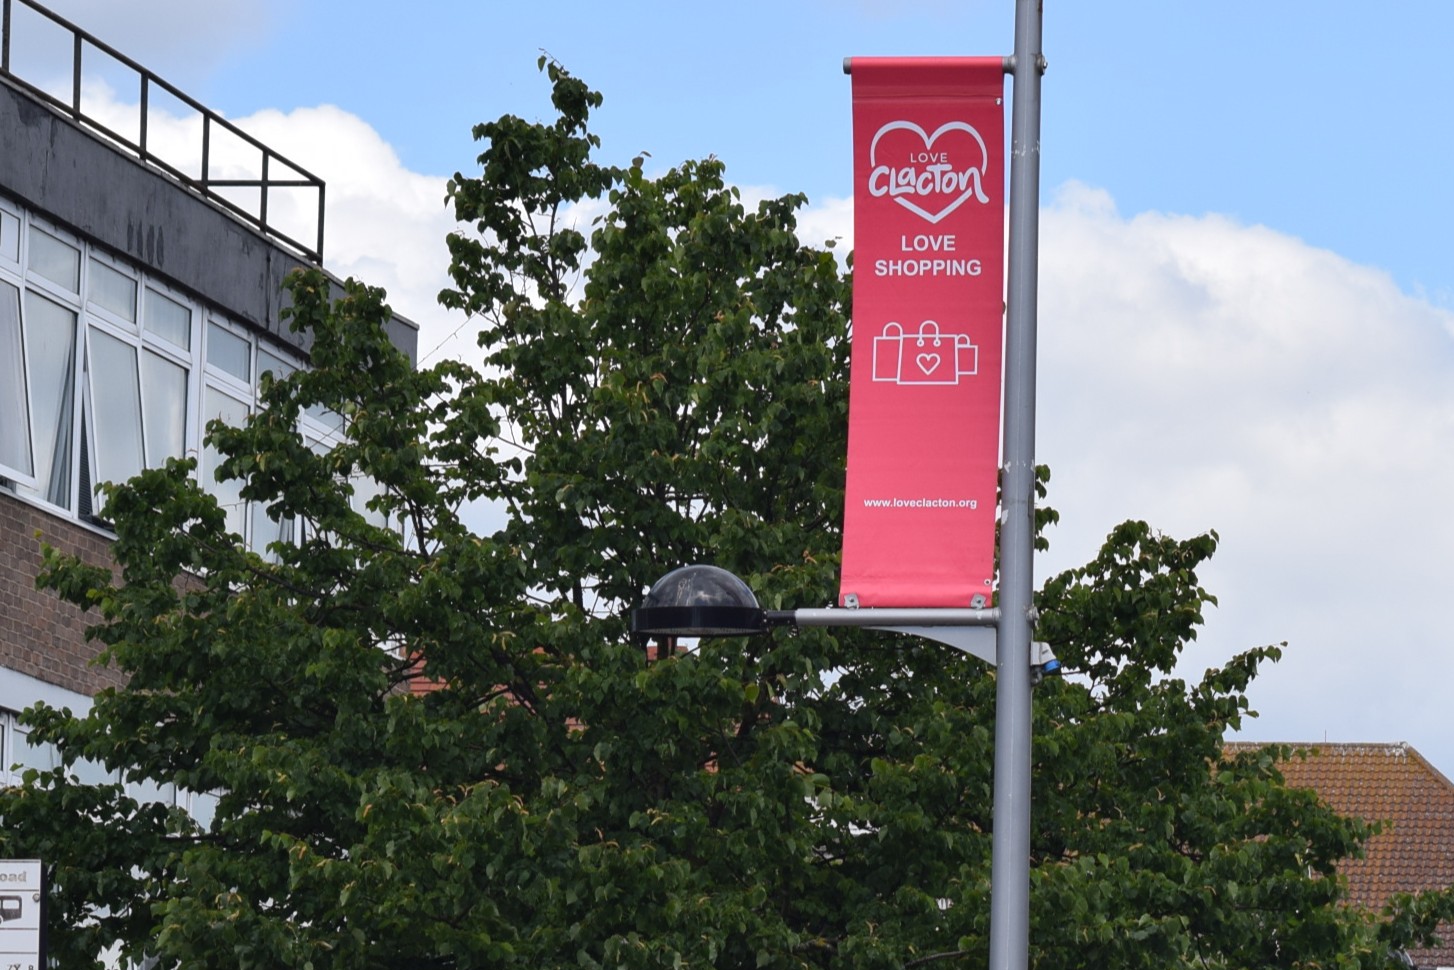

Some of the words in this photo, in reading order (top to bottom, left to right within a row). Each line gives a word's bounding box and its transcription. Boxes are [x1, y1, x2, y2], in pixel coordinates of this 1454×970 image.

[910, 152, 948, 163] LOVE
[901, 235, 956, 252] LOVE
[874, 259, 982, 277] SHOPPING
[863, 498, 977, 510] www.loveclacton.org
